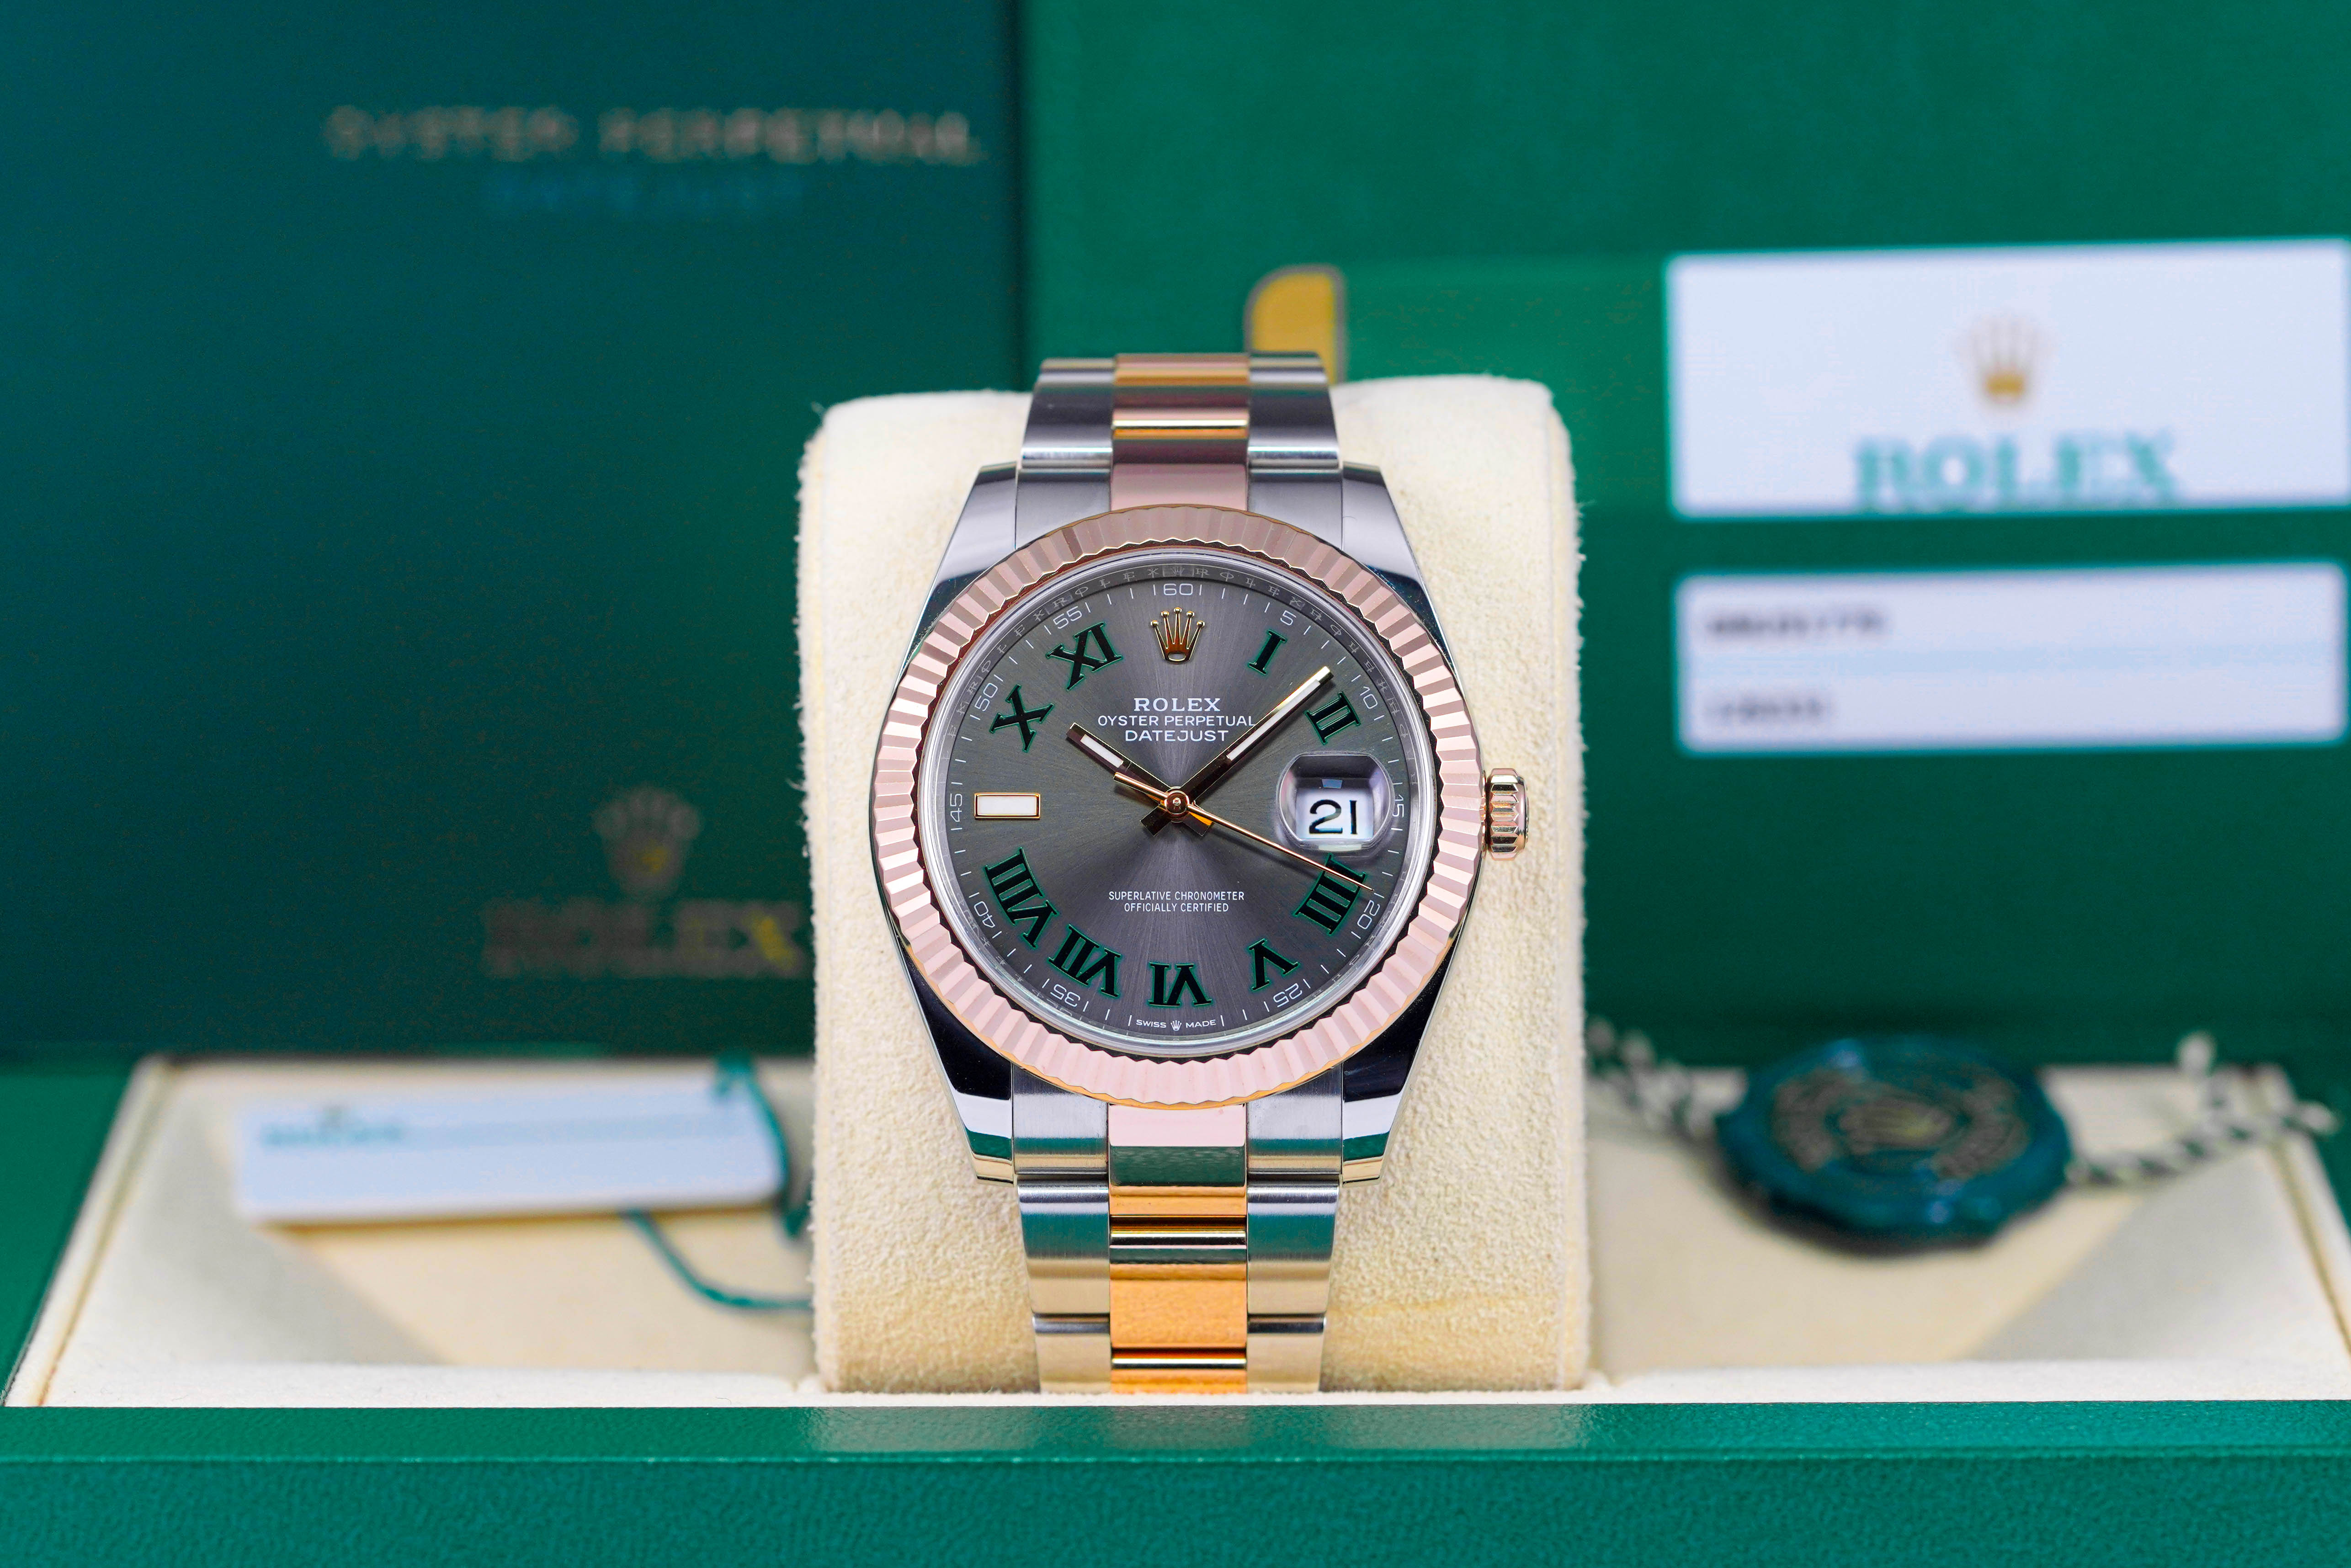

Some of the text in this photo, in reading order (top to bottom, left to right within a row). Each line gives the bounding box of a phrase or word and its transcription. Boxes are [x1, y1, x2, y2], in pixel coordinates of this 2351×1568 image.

[1853, 429, 2179, 511] ROLEX
[1163, 583, 1193, 596] 60
[1053, 606, 1083, 630] 55
[1280, 612, 1297, 626] 5
[1045, 622, 1123, 691] XI
[974, 683, 998, 712] 50
[1133, 697, 1221, 712] ROLEX
[1359, 686, 1378, 709] 10
[1097, 715, 1255, 727] OYSTER PERPETUAL
[1125, 730, 1229, 742] DATEJUST
[950, 793, 963, 822] 45
[1308, 799, 1358, 835] 21
[1108, 891, 1245, 901] SUPERLATIVE CHRONOMETER
[1124, 902, 1229, 912] OFFICIALLY CERTIFIED
[974, 901, 996, 928] 40
[1356, 899, 1381, 930] 20
[1050, 983, 1080, 1008] 35
[1273, 983, 1303, 1008] 25
[1136, 1019, 1217, 1028] SWISS MADE
